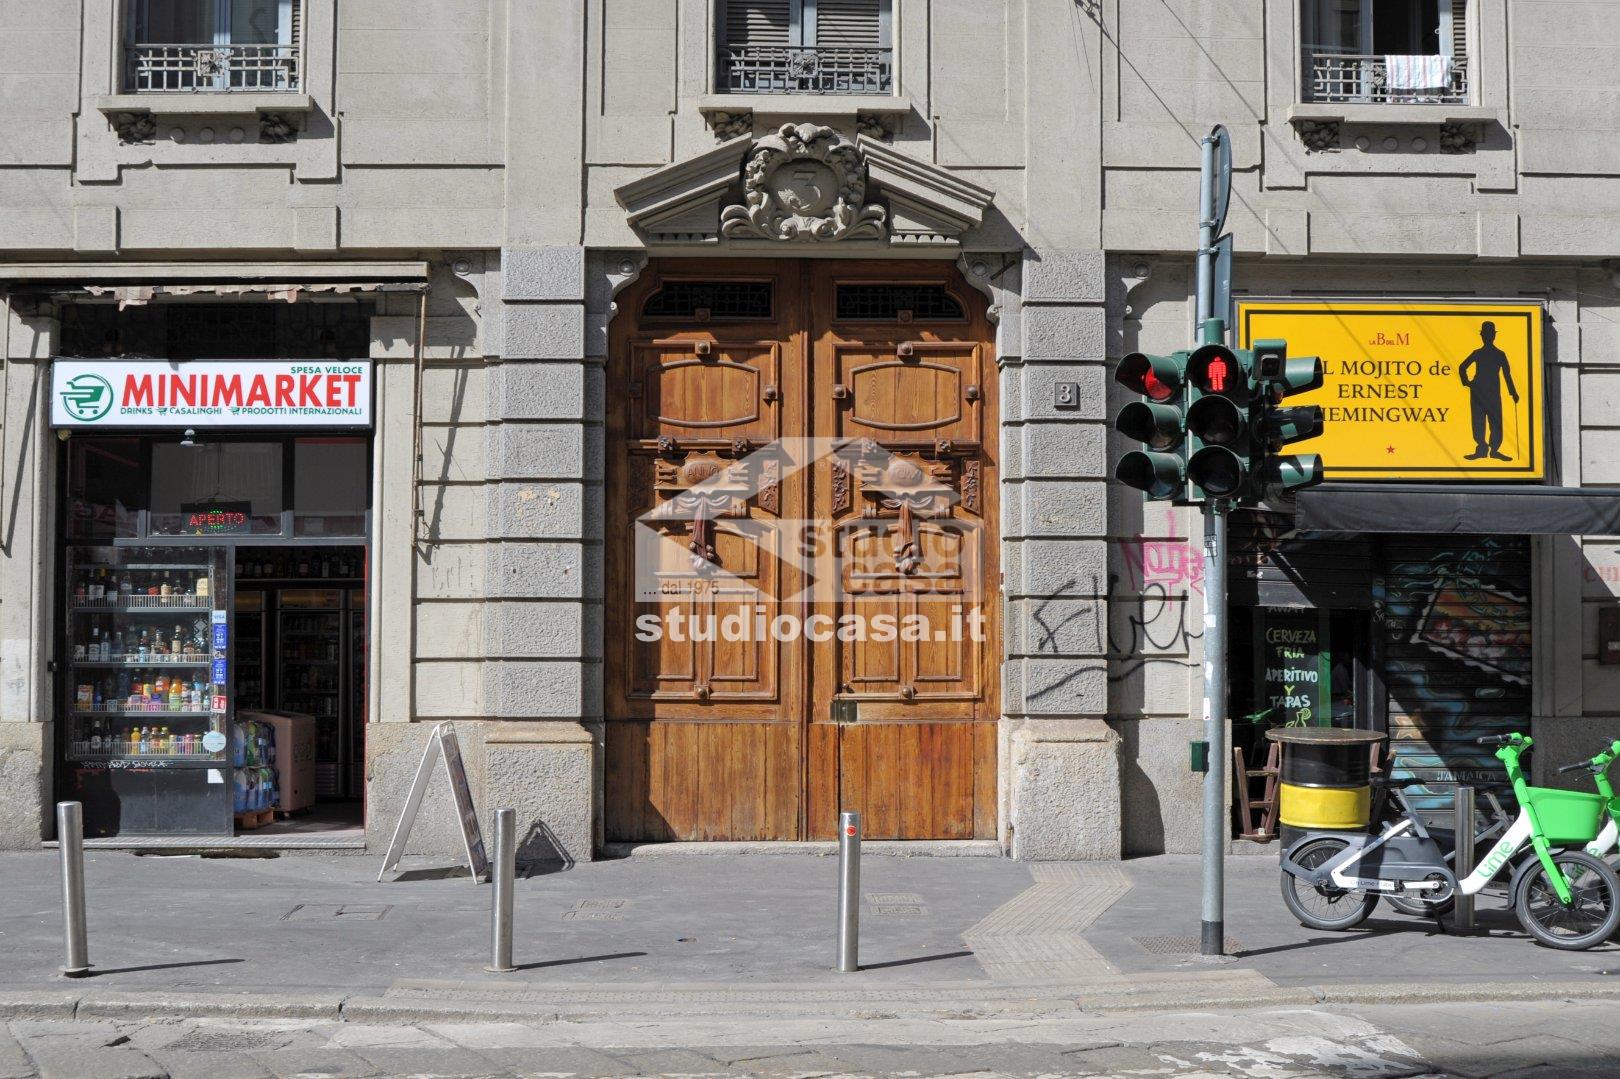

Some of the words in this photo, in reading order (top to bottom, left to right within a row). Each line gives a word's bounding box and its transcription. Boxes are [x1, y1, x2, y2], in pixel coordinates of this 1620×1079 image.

[290, 366, 321, 374] SPESA
[325, 366, 363, 374] VELOCE
[1340, 360, 1422, 379] MOJITO
[1428, 360, 1451, 376] de
[121, 374, 362, 407] MINIMARKET
[1059, 384, 1071, 402] 3
[1337, 383, 1423, 399] ERNEST
[120, 407, 153, 415] DRINKS
[169, 407, 222, 415] CASALINGHI
[242, 407, 287, 415] PRODOTTI
[289, 407, 362, 415] INTERNAZIONALI
[189, 512, 245, 526] APERTO
[1265, 627, 1317, 645] CERVEZA
[1284, 684, 1295, 696] Y
[1269, 694, 1312, 709] TAPAS
